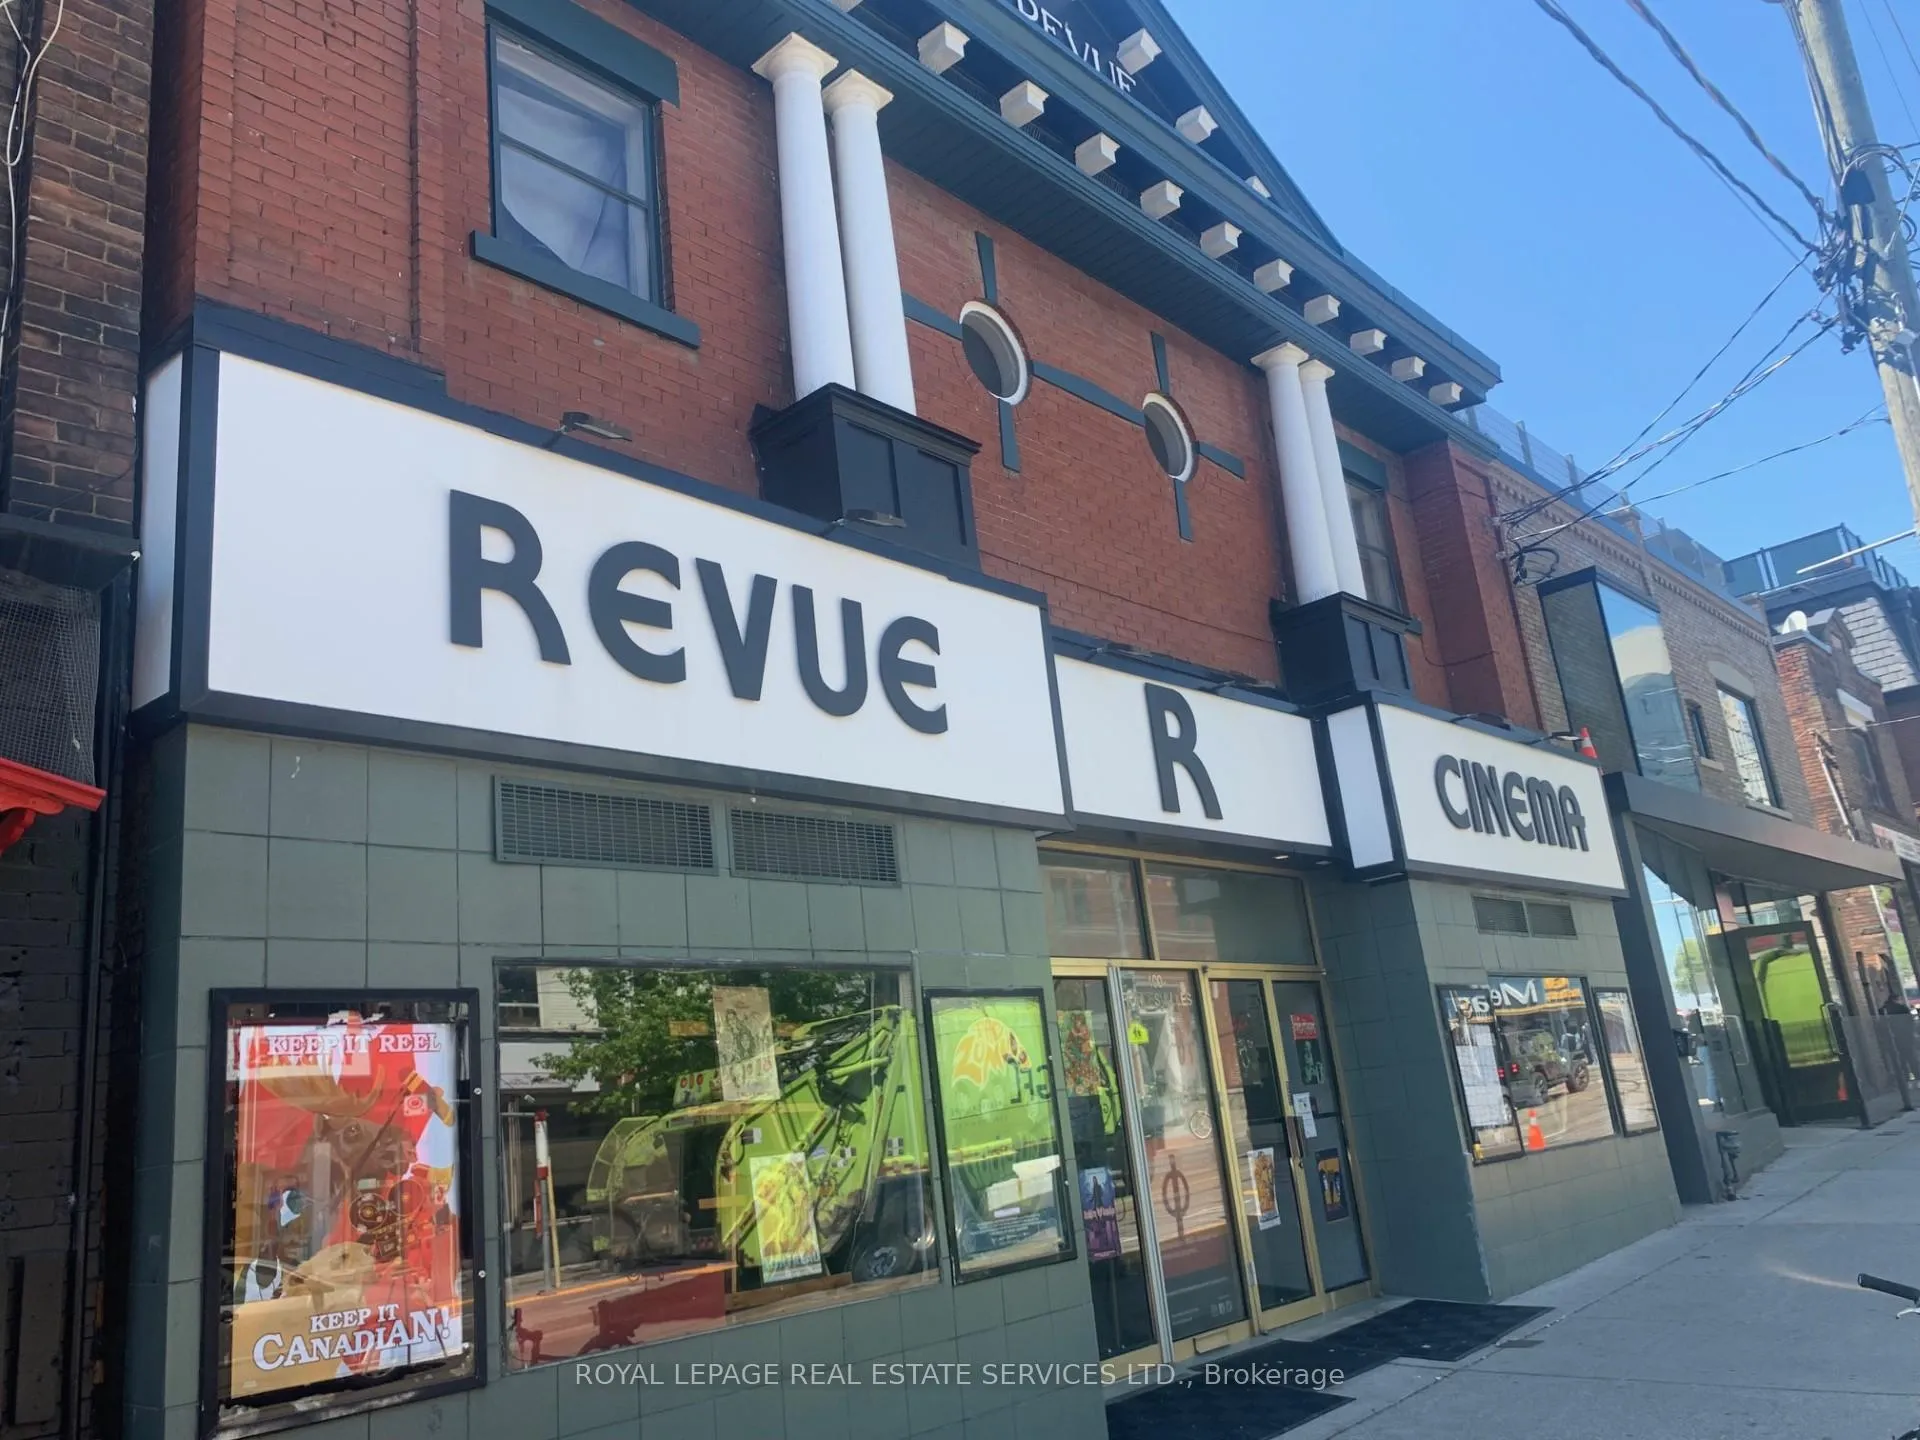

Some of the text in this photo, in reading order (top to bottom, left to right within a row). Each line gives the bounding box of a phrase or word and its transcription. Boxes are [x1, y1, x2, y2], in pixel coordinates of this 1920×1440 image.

[449, 490, 948, 734] REVUE
[1144, 683, 1223, 819] R
[1435, 754, 1588, 852] CINEMA
[267, 1032, 441, 1056] KEEP IT REEL
[252, 1306, 451, 1372] CANADIAN!
[310, 1303, 399, 1334] KEEP IT
